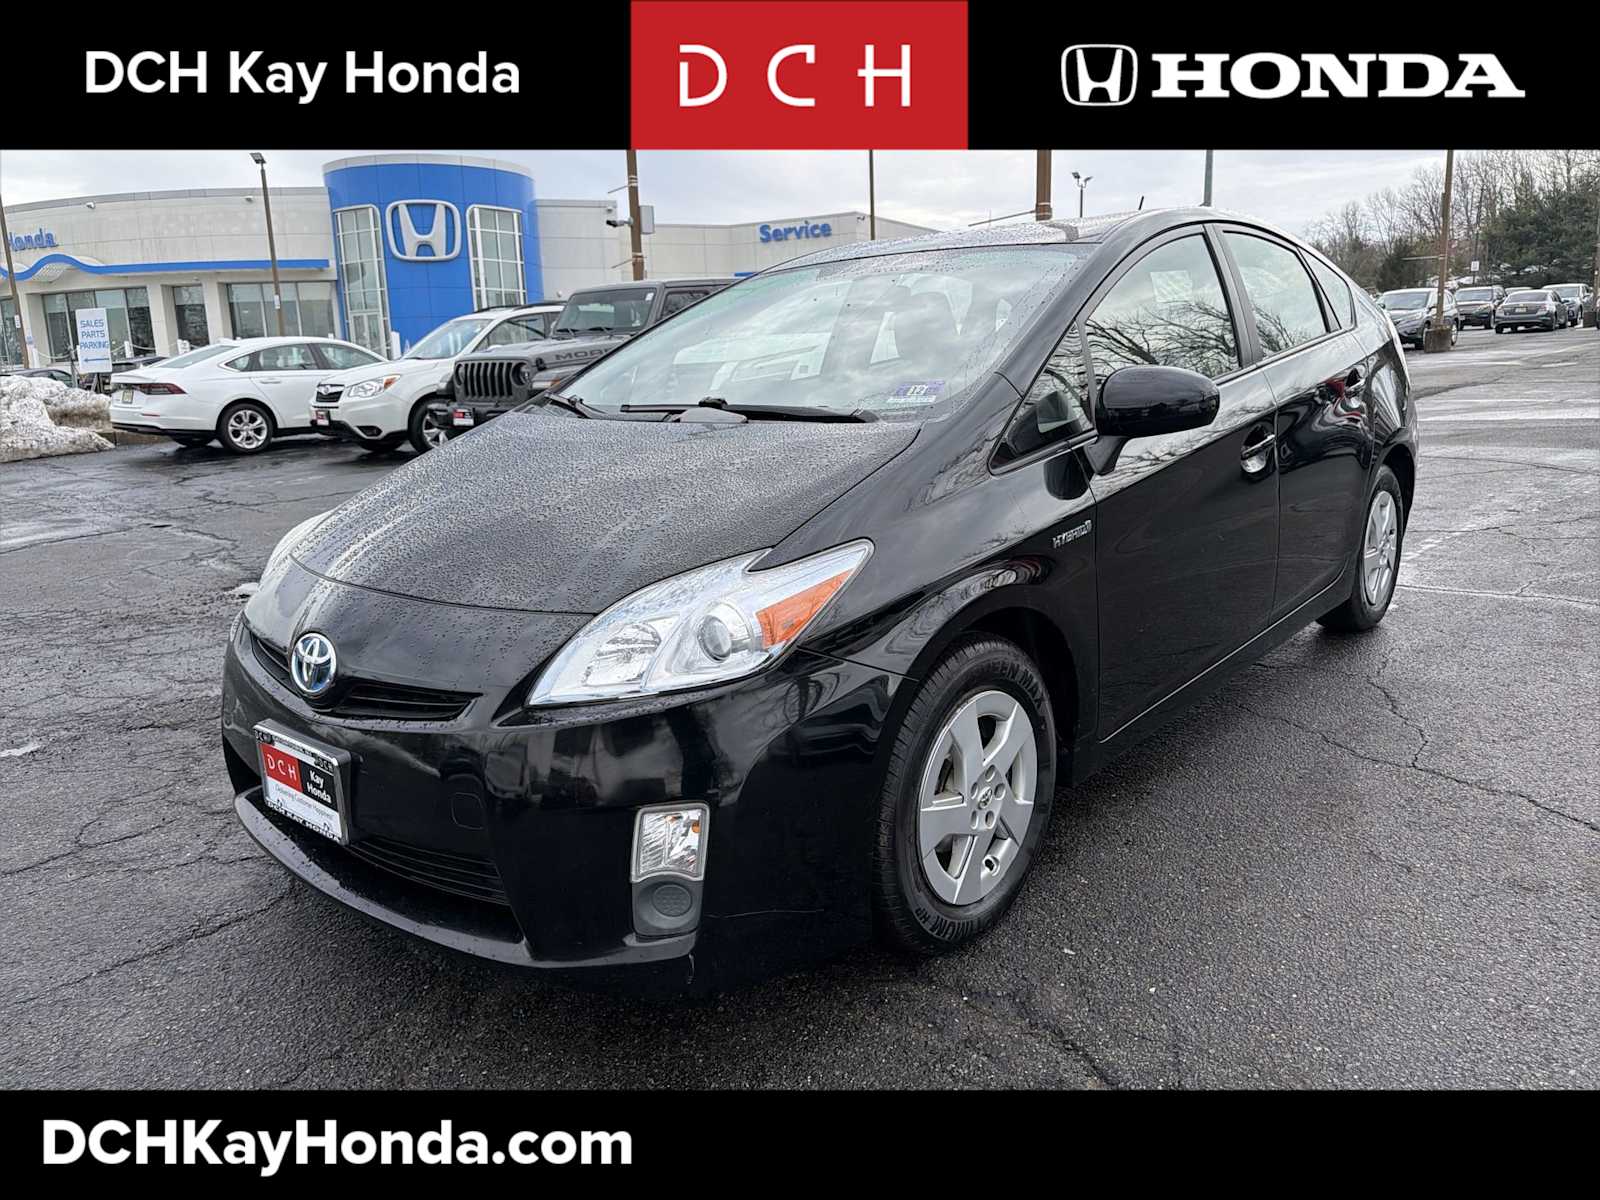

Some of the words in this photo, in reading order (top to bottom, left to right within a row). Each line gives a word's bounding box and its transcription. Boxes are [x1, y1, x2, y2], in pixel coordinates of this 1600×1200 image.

[760, 220, 832, 242] Service
[80, 320, 104, 329] SALES
[81, 330, 106, 338] PARTS
[80, 341, 111, 350] PARKING
[1053, 520, 1091, 548] HYBRID
[267, 754, 297, 781] DCH
[309, 770, 324, 788] Kay
[306, 782, 332, 803] Honda
